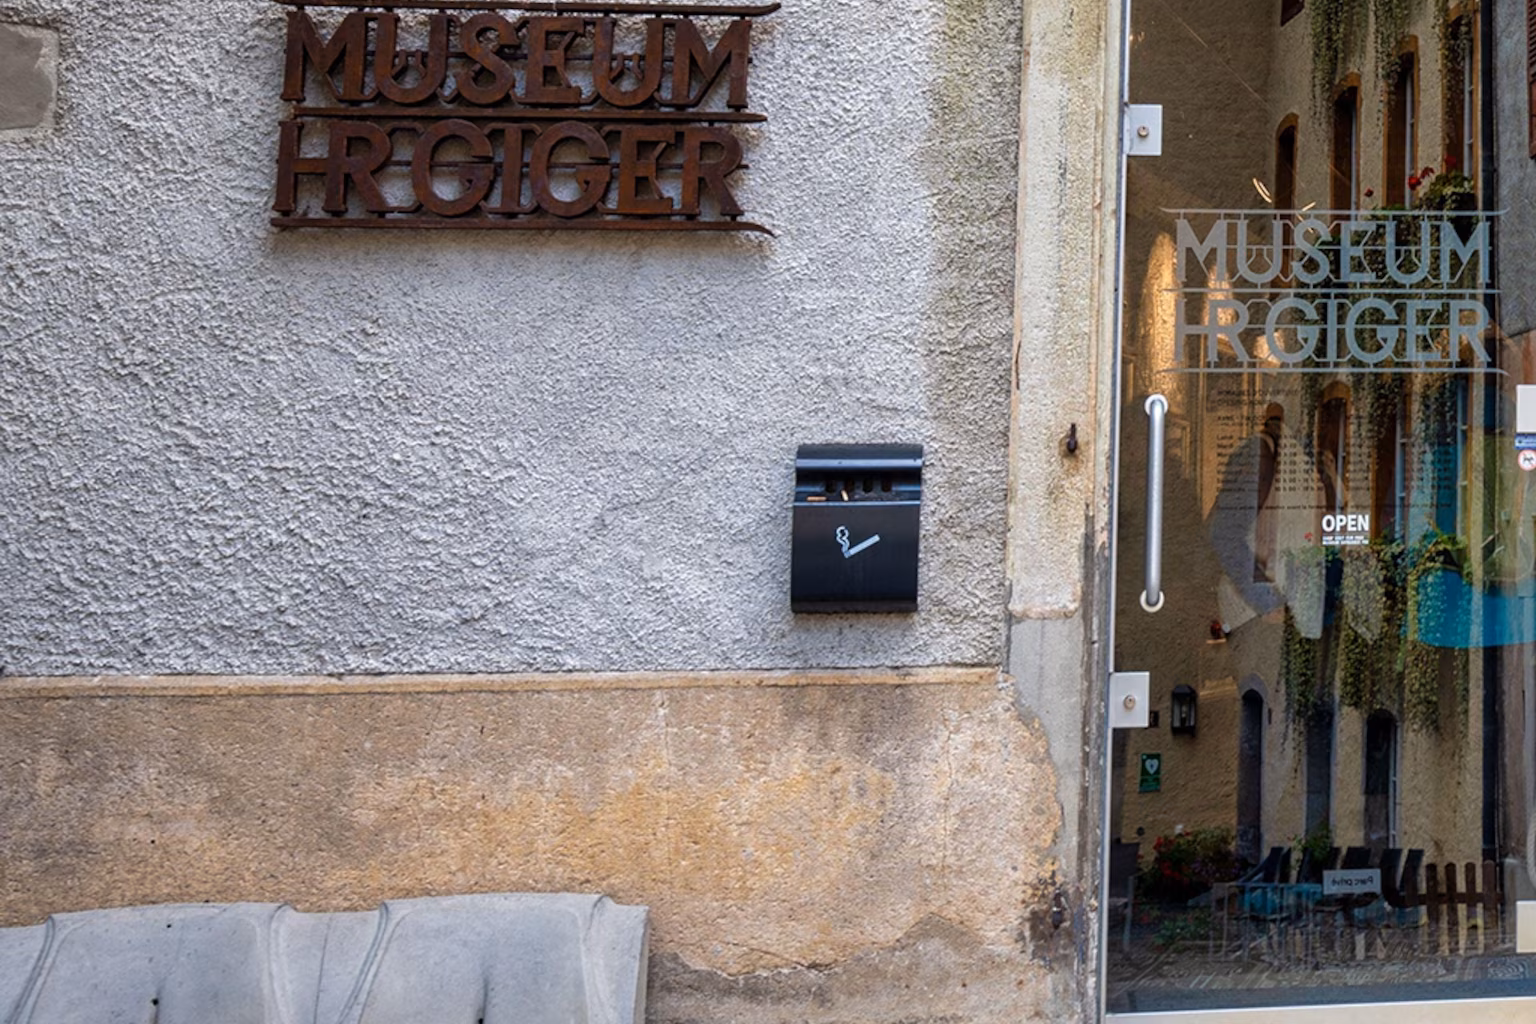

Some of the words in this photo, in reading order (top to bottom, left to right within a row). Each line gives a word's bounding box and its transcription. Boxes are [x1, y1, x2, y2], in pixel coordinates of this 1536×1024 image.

[280, 10, 753, 109] MUSEUM
[411, 118, 744, 218] GIGER
[1175, 218, 1492, 285] MUSEUM
[1264, 297, 1493, 364] GIGER
[1321, 514, 1370, 533] OPEN
